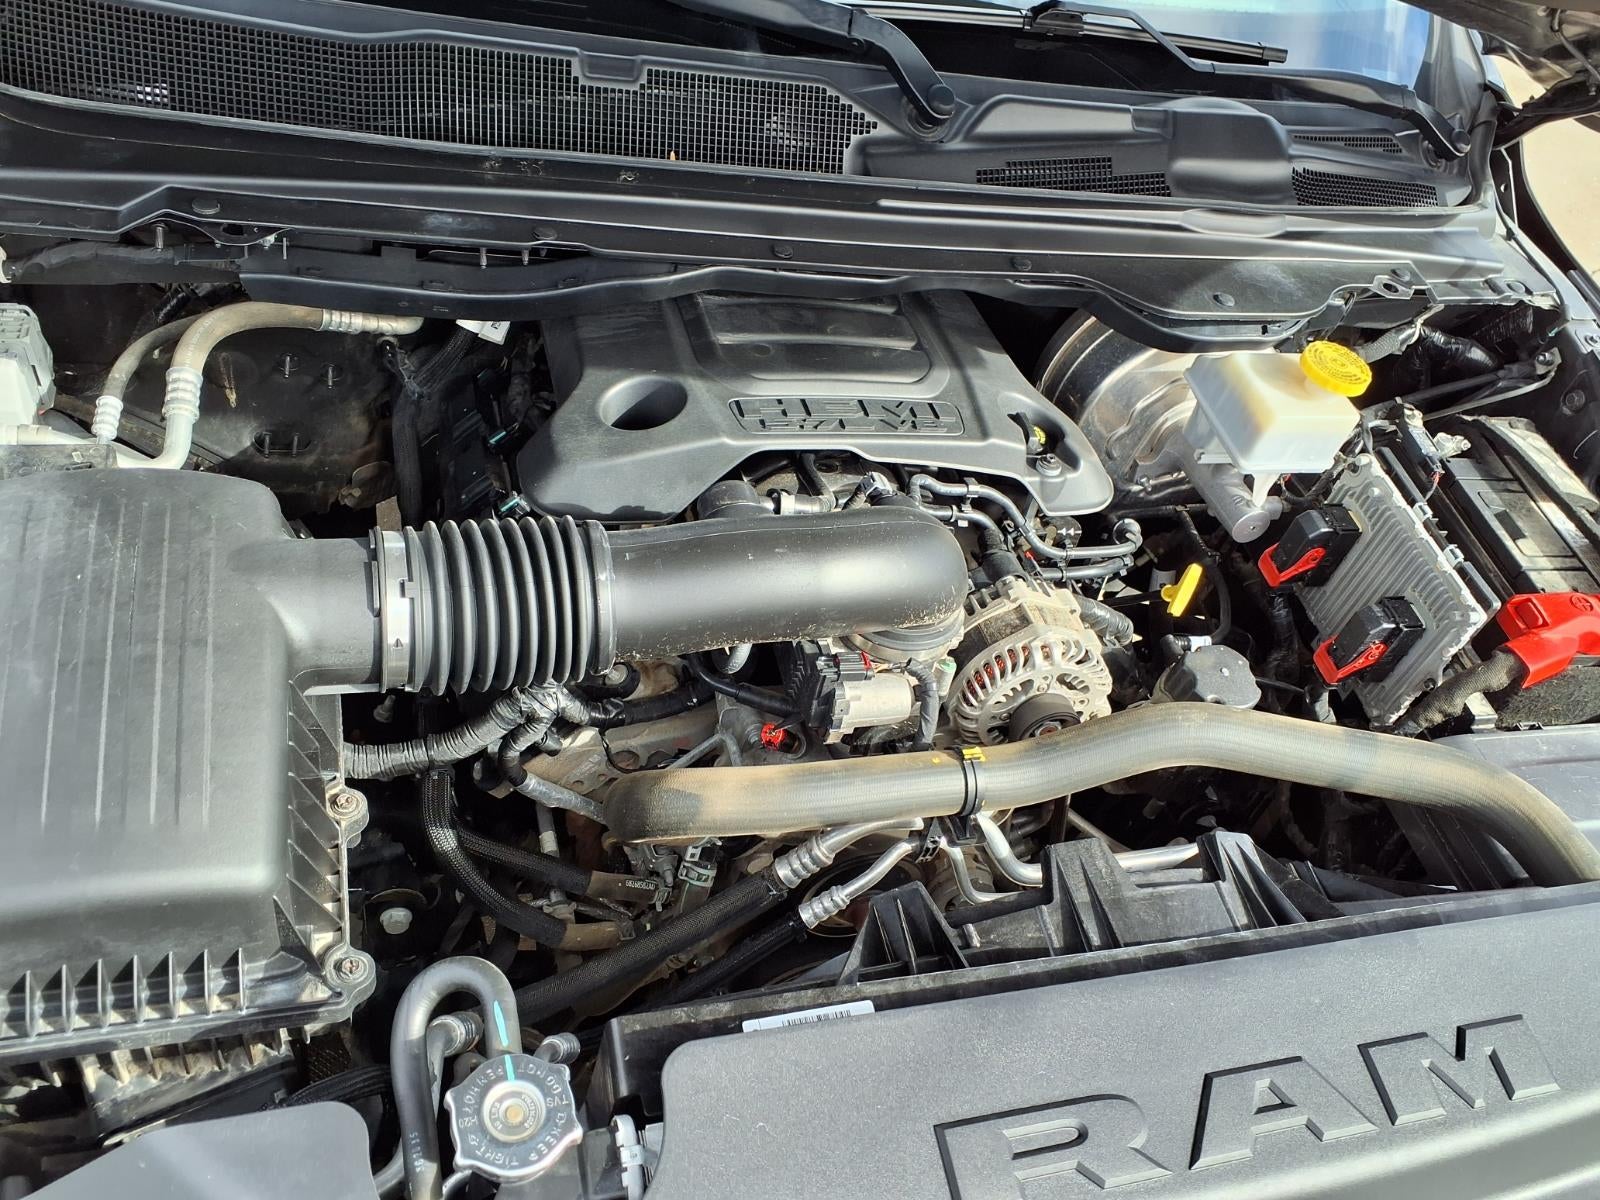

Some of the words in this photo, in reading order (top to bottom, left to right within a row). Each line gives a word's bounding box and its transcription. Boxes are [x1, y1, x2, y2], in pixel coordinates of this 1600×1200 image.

[733, 398, 956, 421] HEMI
[546, 1094, 569, 1108] TVS
[933, 1014, 1561, 1200] RAM
[527, 1125, 563, 1161] KEEP
[475, 1145, 520, 1168] TIGHT
